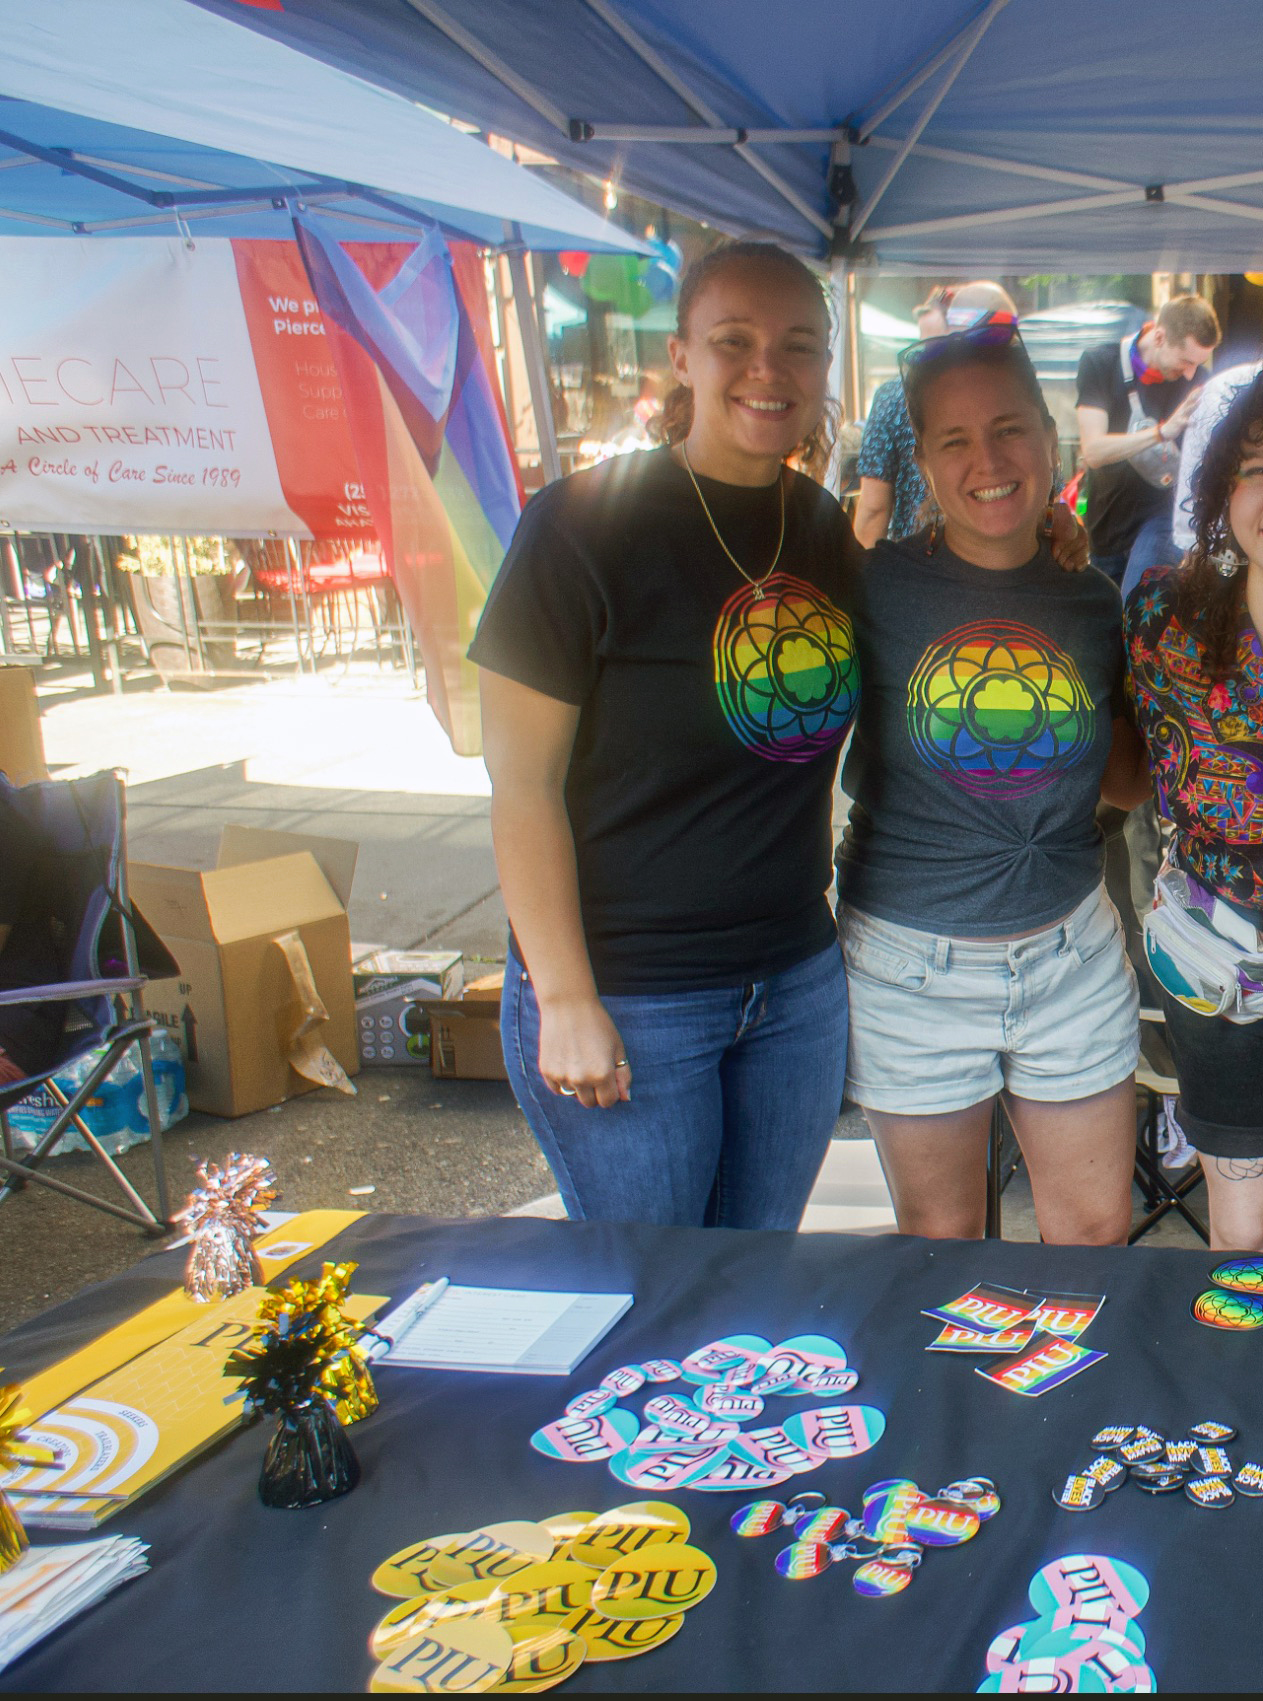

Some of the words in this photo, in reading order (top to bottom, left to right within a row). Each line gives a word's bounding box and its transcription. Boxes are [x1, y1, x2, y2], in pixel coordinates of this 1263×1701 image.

[269, 296, 298, 313] We
[18, 426, 82, 445] AND
[84, 426, 236, 452] TREATMENT
[28, 456, 77, 477] Circle
[84, 461, 99, 483] of
[108, 460, 146, 483] Care
[152, 465, 195, 486] Since
[202, 467, 241, 488] 1989
[179, 984, 192, 996] UP
[952, 1297, 1020, 1328] PLU
[646, 1360, 677, 1376] PLU
[1002, 1343, 1082, 1388] PLU
[608, 1370, 640, 1391] PLU
[572, 1389, 612, 1412] PLU
[718, 1396, 757, 1411] PLU
[119, 1408, 149, 1429] SEEKERS
[664, 1408, 703, 1429] PLU
[811, 1411, 857, 1450] PLU
[556, 1416, 613, 1456] PLU
[751, 1431, 814, 1468] PLU
[1166, 1441, 1198, 1449] BLACK
[1061, 1475, 1076, 1504] MATTER
[1068, 1477, 1087, 1505] LIVES
[1081, 1477, 1096, 1506] BLACK
[910, 1507, 974, 1537] PLU
[446, 1532, 536, 1580] PLU
[596, 1568, 712, 1606] PLU
[860, 1564, 911, 1590] PLU
[386, 1636, 502, 1693] PLU
